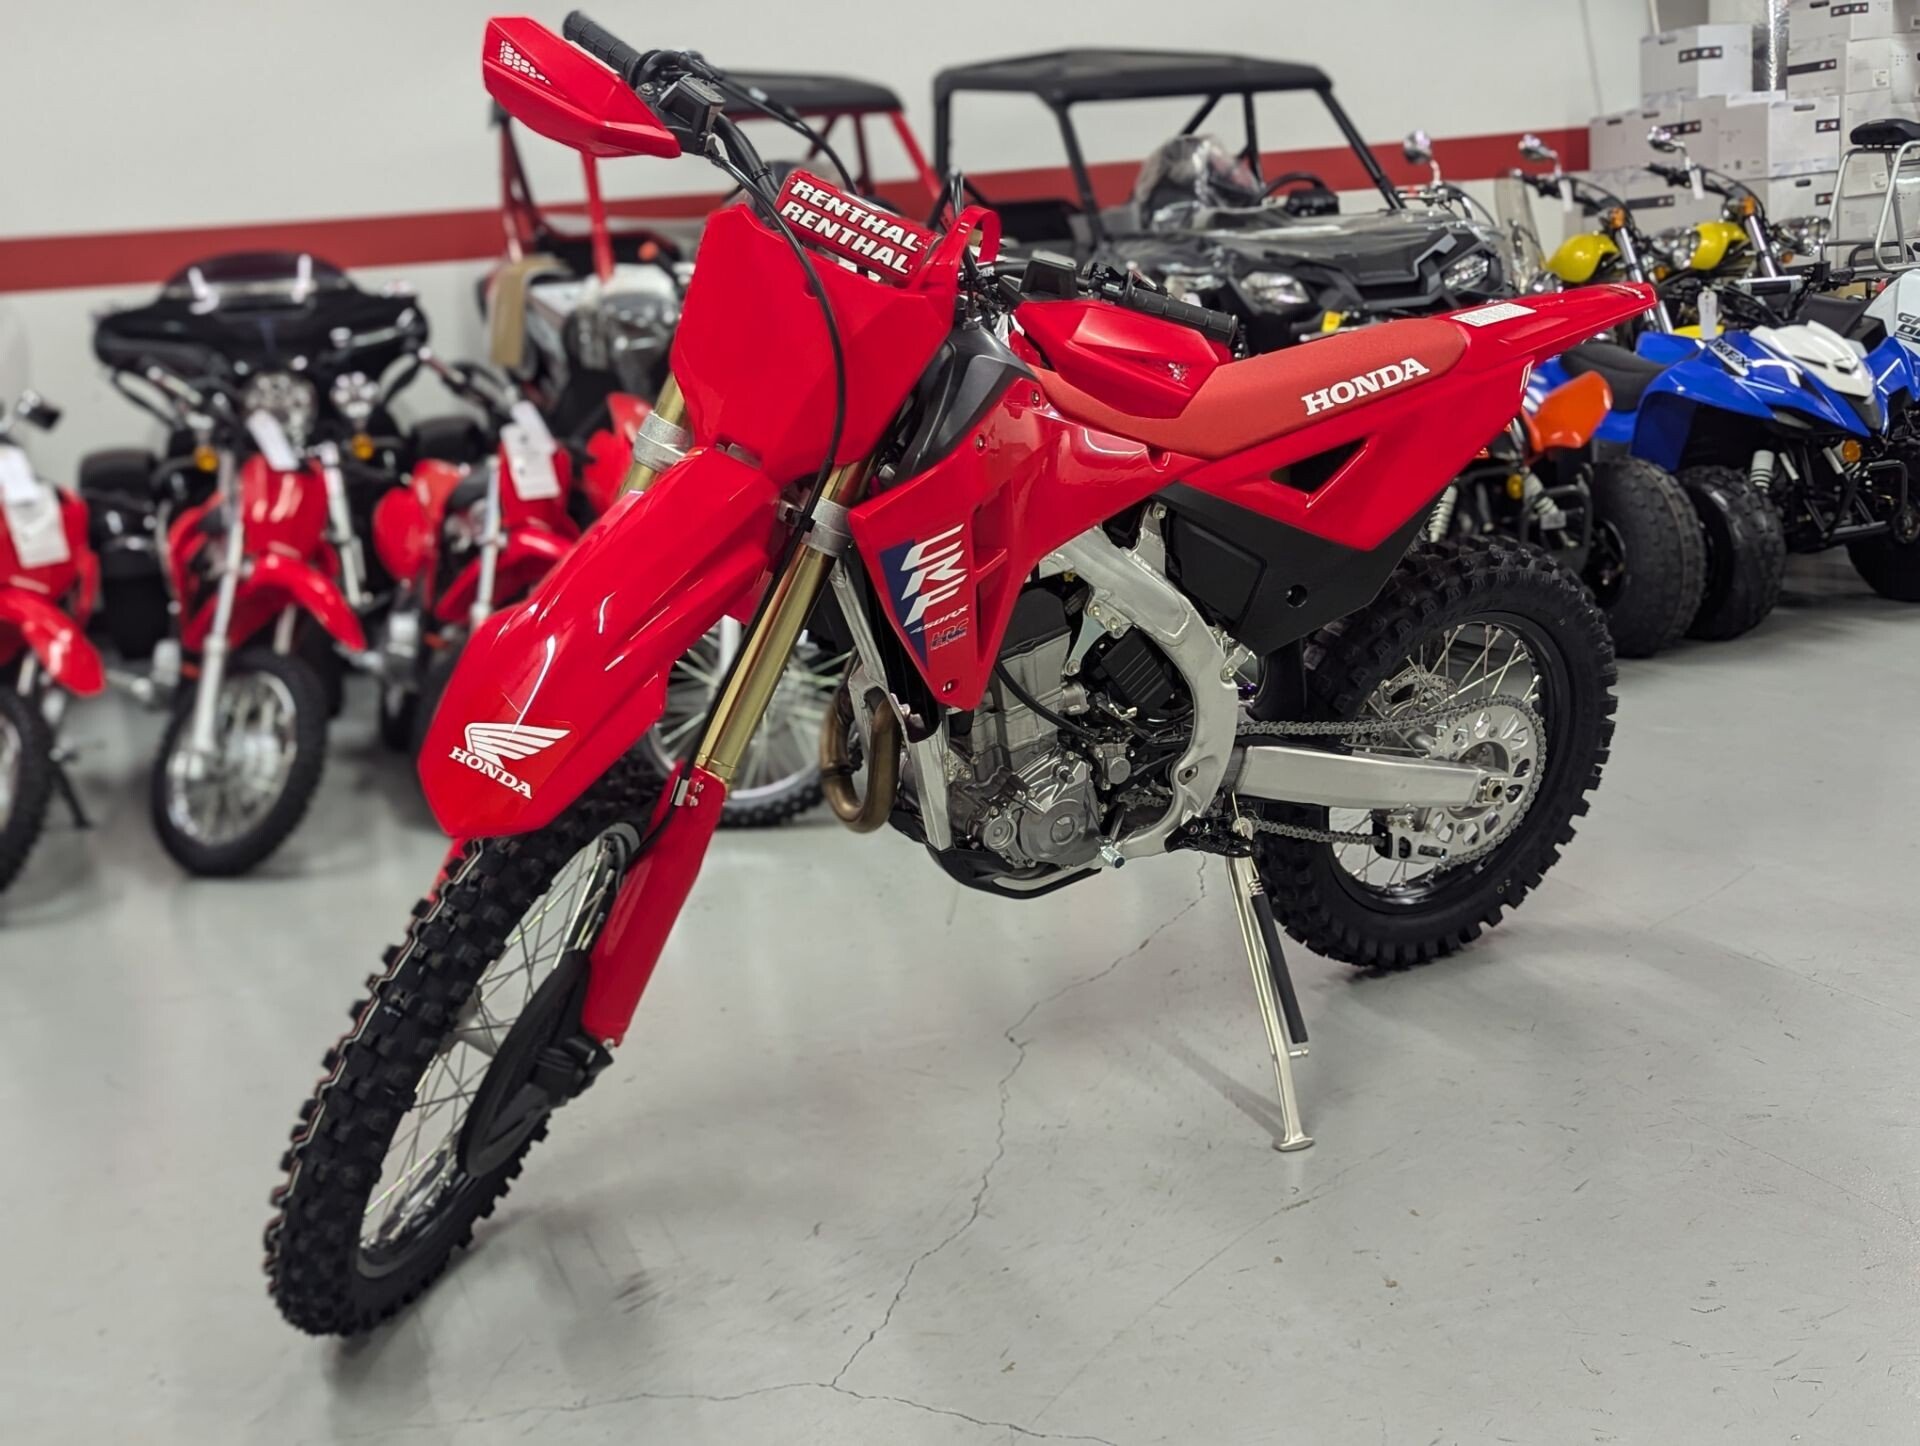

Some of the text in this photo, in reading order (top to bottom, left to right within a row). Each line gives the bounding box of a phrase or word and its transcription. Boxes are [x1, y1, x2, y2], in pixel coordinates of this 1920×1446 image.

[780, 201, 909, 274] RENTHAL
[790, 180, 919, 252] RENTHAL
[1301, 358, 1430, 416] HONDA
[900, 523, 968, 628] CRF
[448, 746, 533, 800] HONDA
